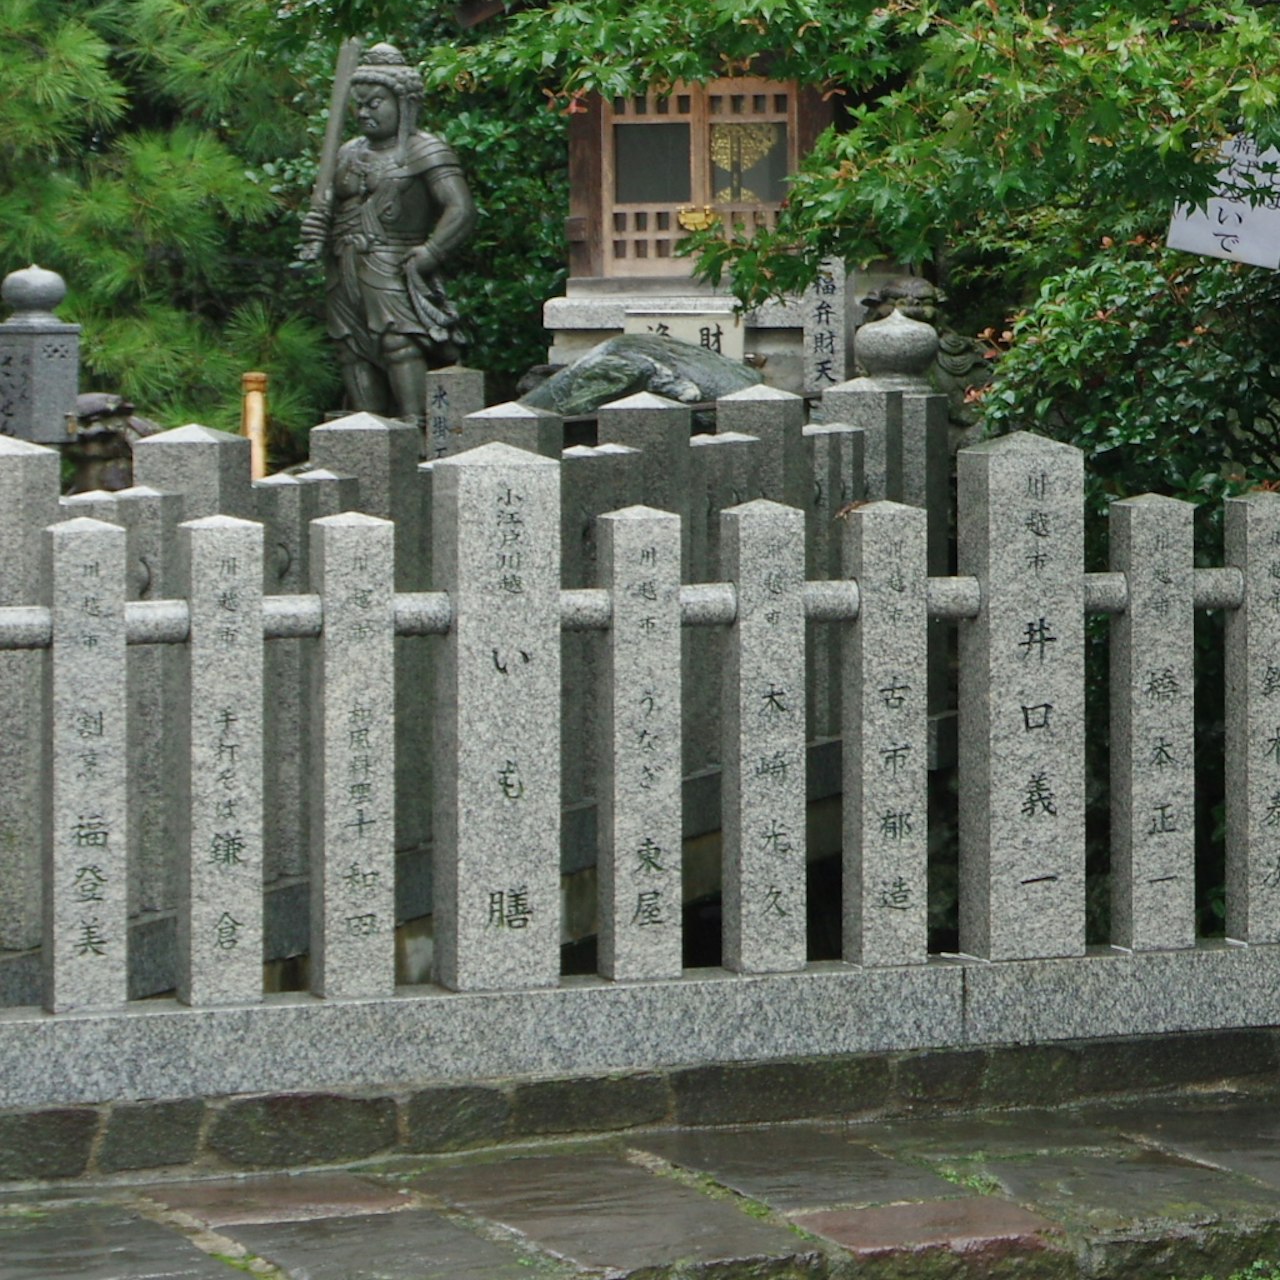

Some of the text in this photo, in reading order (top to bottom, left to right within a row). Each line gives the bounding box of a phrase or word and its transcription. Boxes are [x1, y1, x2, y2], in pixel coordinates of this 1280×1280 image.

[812, 259, 838, 384] 福弁財天
[1026, 474, 1049, 578] 川越市
[486, 486, 534, 932] 小江戸川越 いも膳
[632, 844, 666, 929] 東屋
